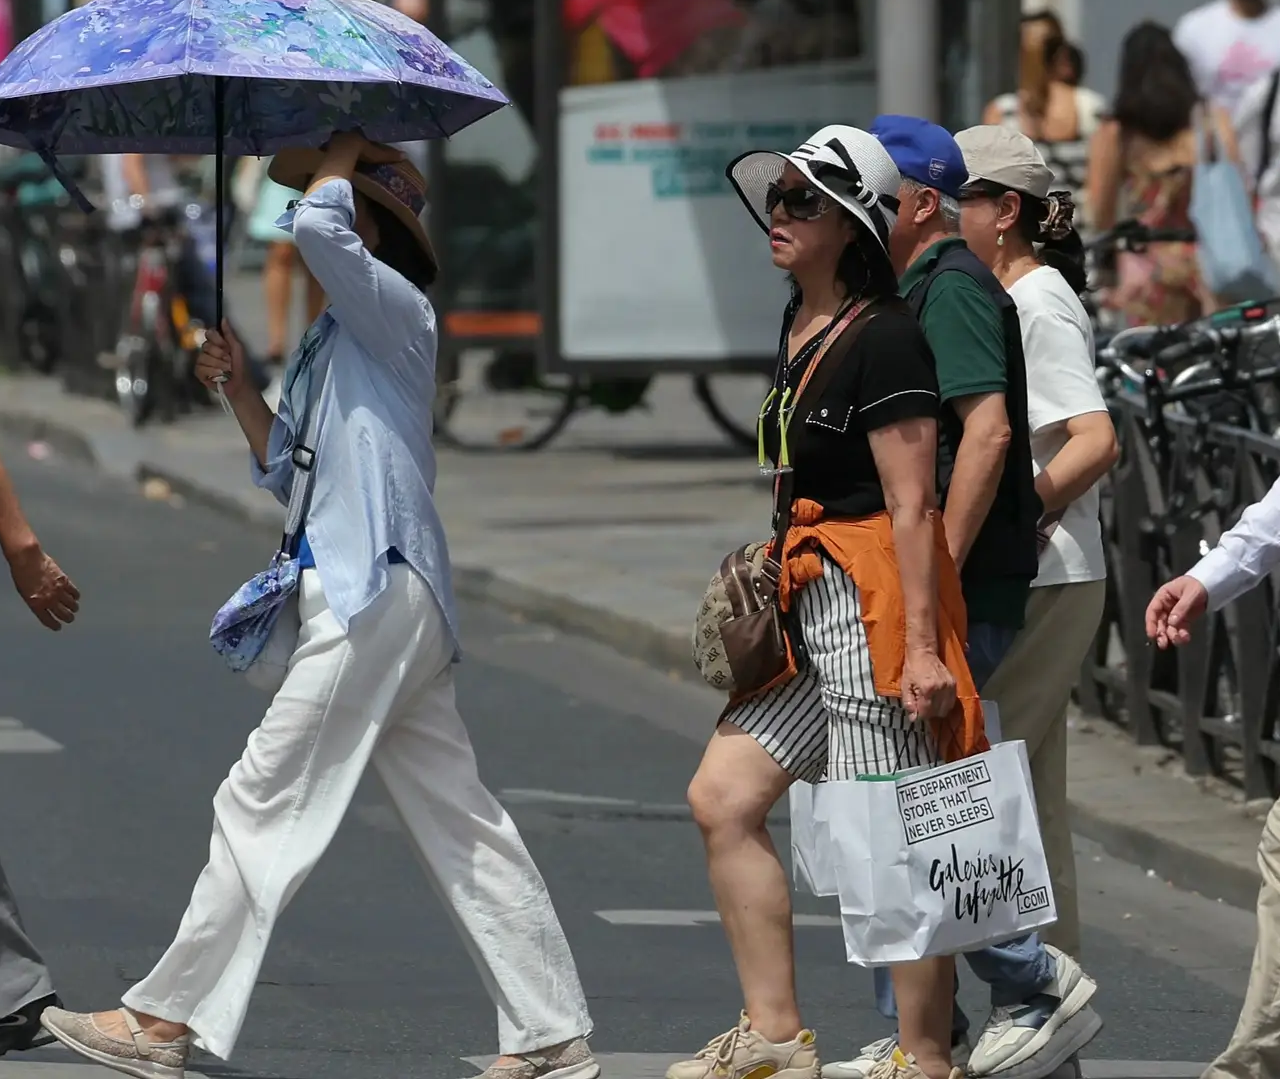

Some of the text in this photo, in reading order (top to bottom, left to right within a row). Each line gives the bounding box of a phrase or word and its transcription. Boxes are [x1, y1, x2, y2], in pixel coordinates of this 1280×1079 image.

[899, 766, 984, 803] THE DEPARTMENT
[903, 790, 967, 821] STORE THAT
[908, 804, 989, 840] NEVER SLEEPS
[1020, 894, 1046, 910] .COM
